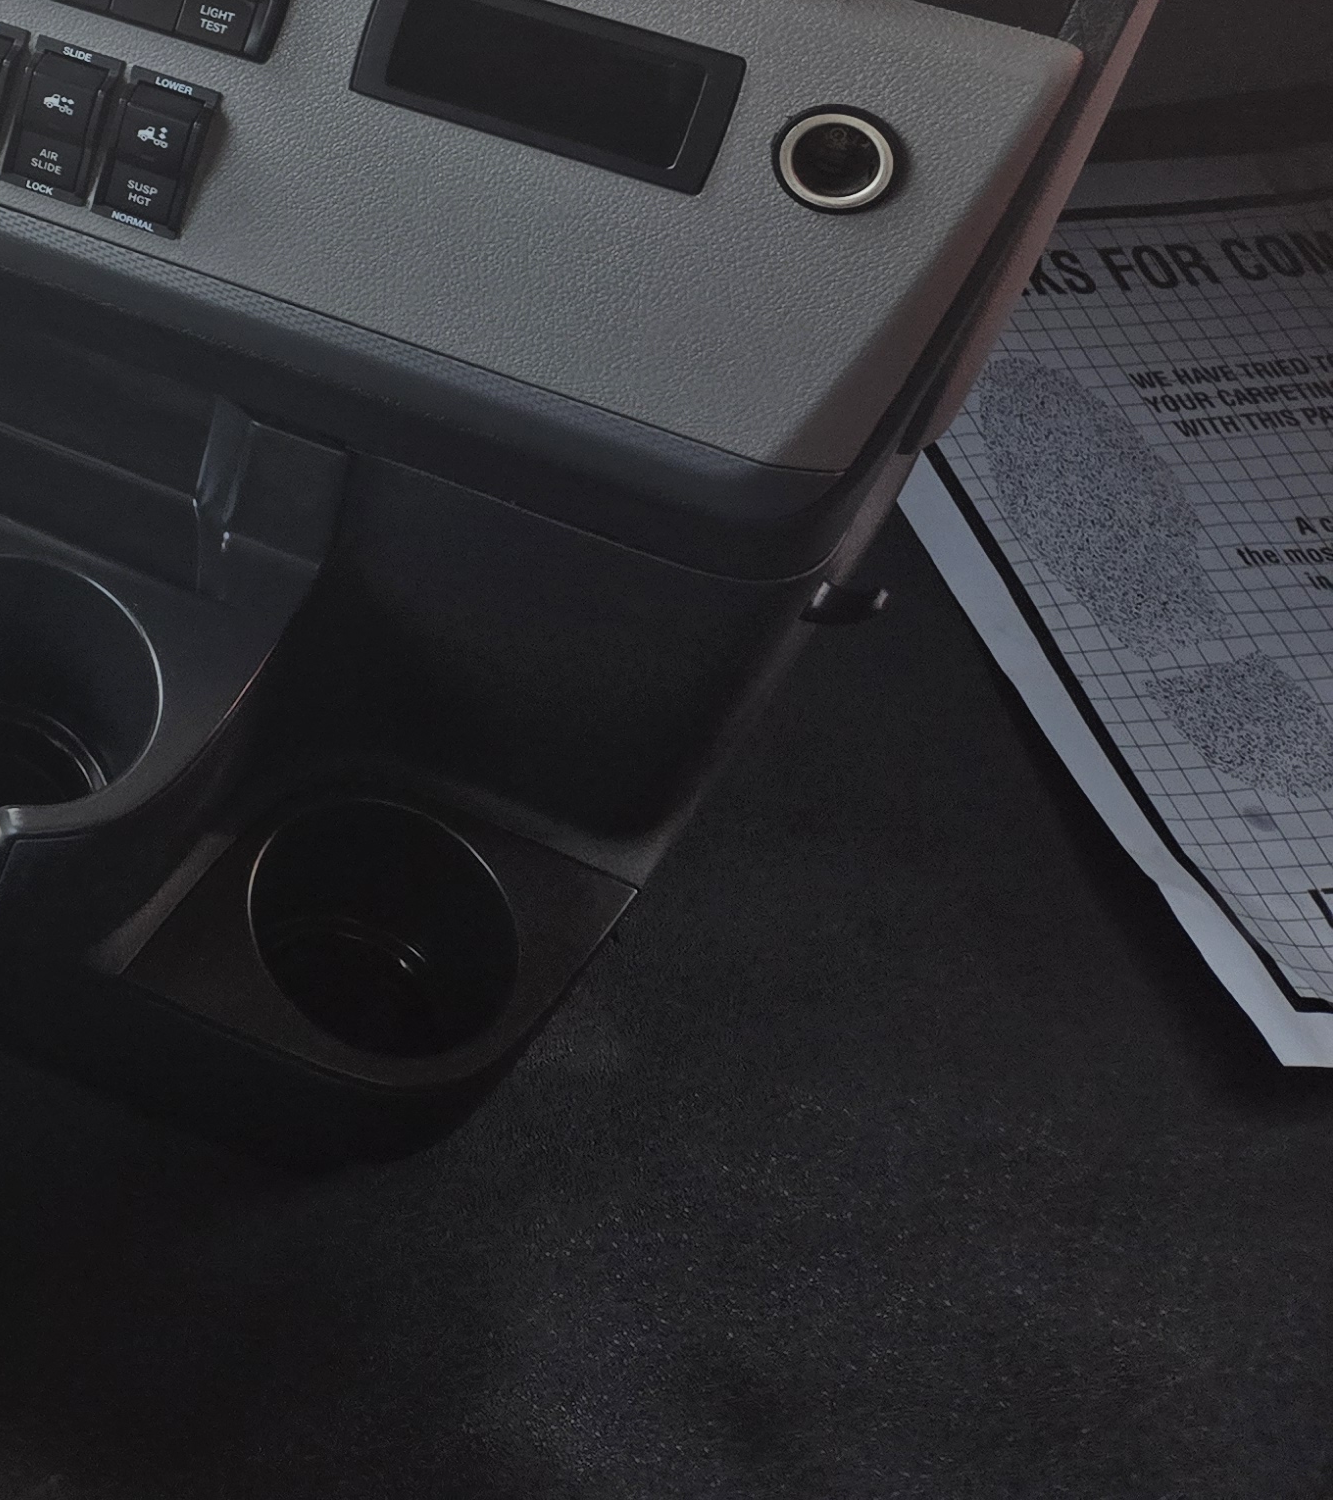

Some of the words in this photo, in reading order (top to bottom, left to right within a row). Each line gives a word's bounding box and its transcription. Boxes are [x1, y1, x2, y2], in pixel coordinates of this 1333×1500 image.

[199, 4, 236, 23] LIGHT
[199, 18, 228, 35] TEST
[63, 46, 93, 63] SLIDE
[155, 76, 194, 96] LOWER
[39, 148, 59, 162] AIR
[30, 157, 63, 176] SLIDE
[26, 179, 54, 196] LOCK
[127, 179, 158, 197] SUSP
[128, 192, 152, 208] HGT
[111, 210, 155, 233] NORMAL
[1097, 242, 1222, 292] FOR
[1130, 369, 1173, 390] WE
[1172, 363, 1237, 386] HAVE
[1236, 357, 1310, 380] TRIED
[1144, 392, 1216, 414] YOUR
[1172, 414, 1242, 438] WITH
[1240, 409, 1301, 431] THIS
[1296, 516, 1317, 535] A
[1237, 547, 1280, 567] the
